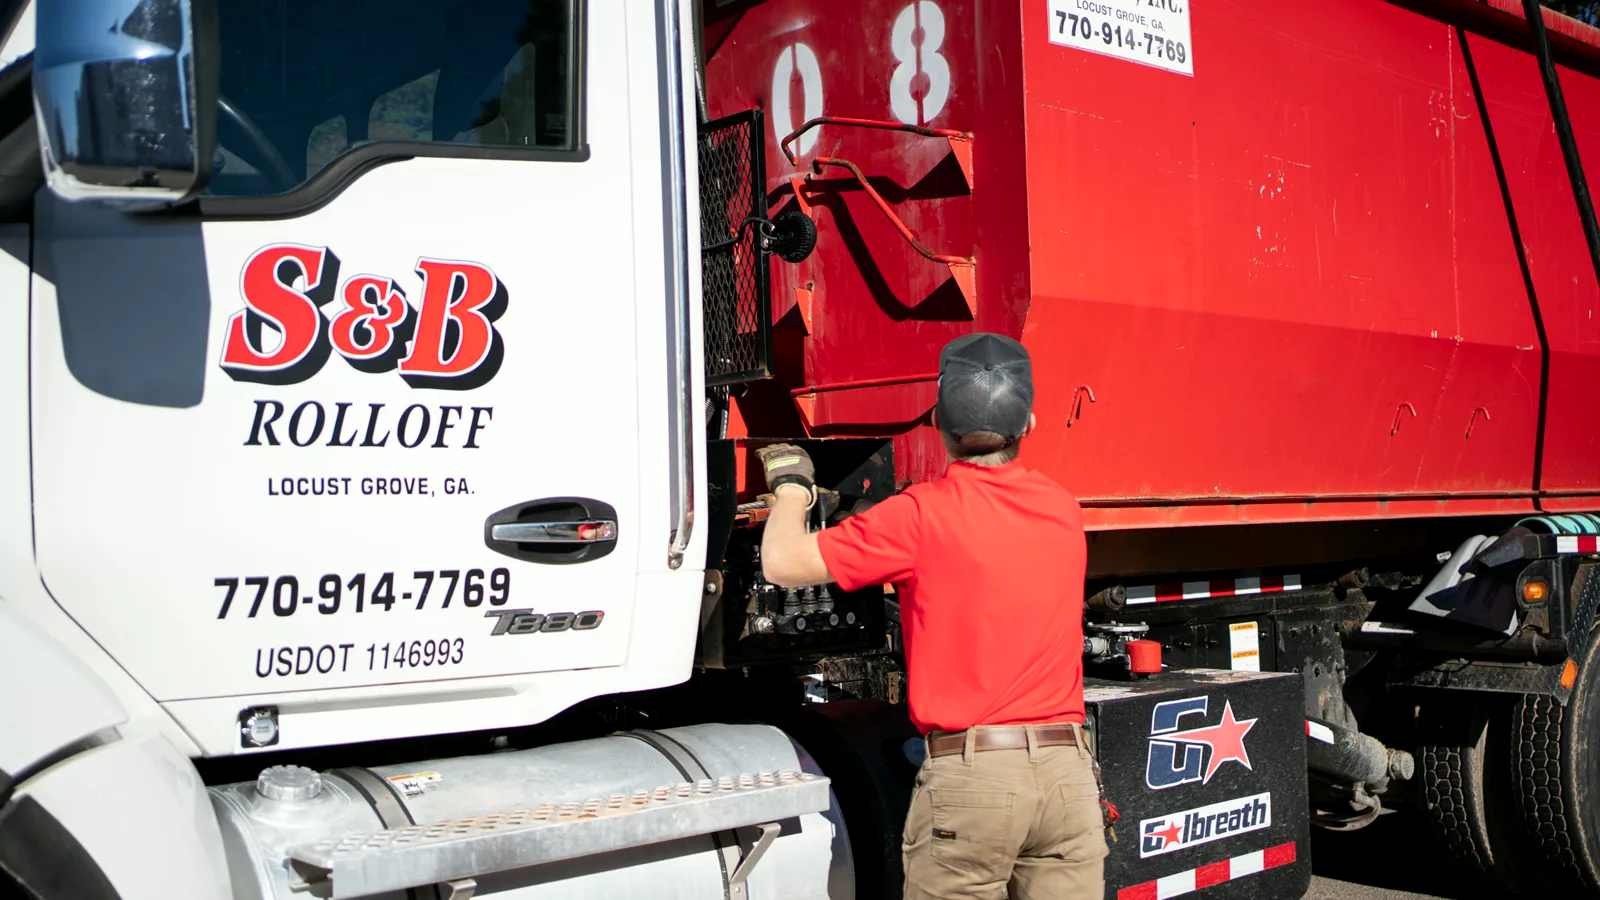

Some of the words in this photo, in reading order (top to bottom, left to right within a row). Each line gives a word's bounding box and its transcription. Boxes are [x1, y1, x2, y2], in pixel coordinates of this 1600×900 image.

[1056, 10, 1186, 64] 770-914-7769
[1077, 0, 1113, 16] LOCUST
[1115, 9, 1149, 28] GROVE,
[1151, 19, 1166, 31] GA.
[890, 0, 951, 125] 8
[219, 243, 508, 391] S&B
[243, 400, 493, 449] ROLLOFF
[268, 477, 352, 496] LOCUST
[361, 477, 435, 498] GROVE,
[444, 477, 476, 495] GA.
[214, 567, 511, 620] 770-914-7769
[484, 608, 605, 636] T880
[255, 643, 355, 678] USDOT
[366, 637, 465, 671] 1146993
